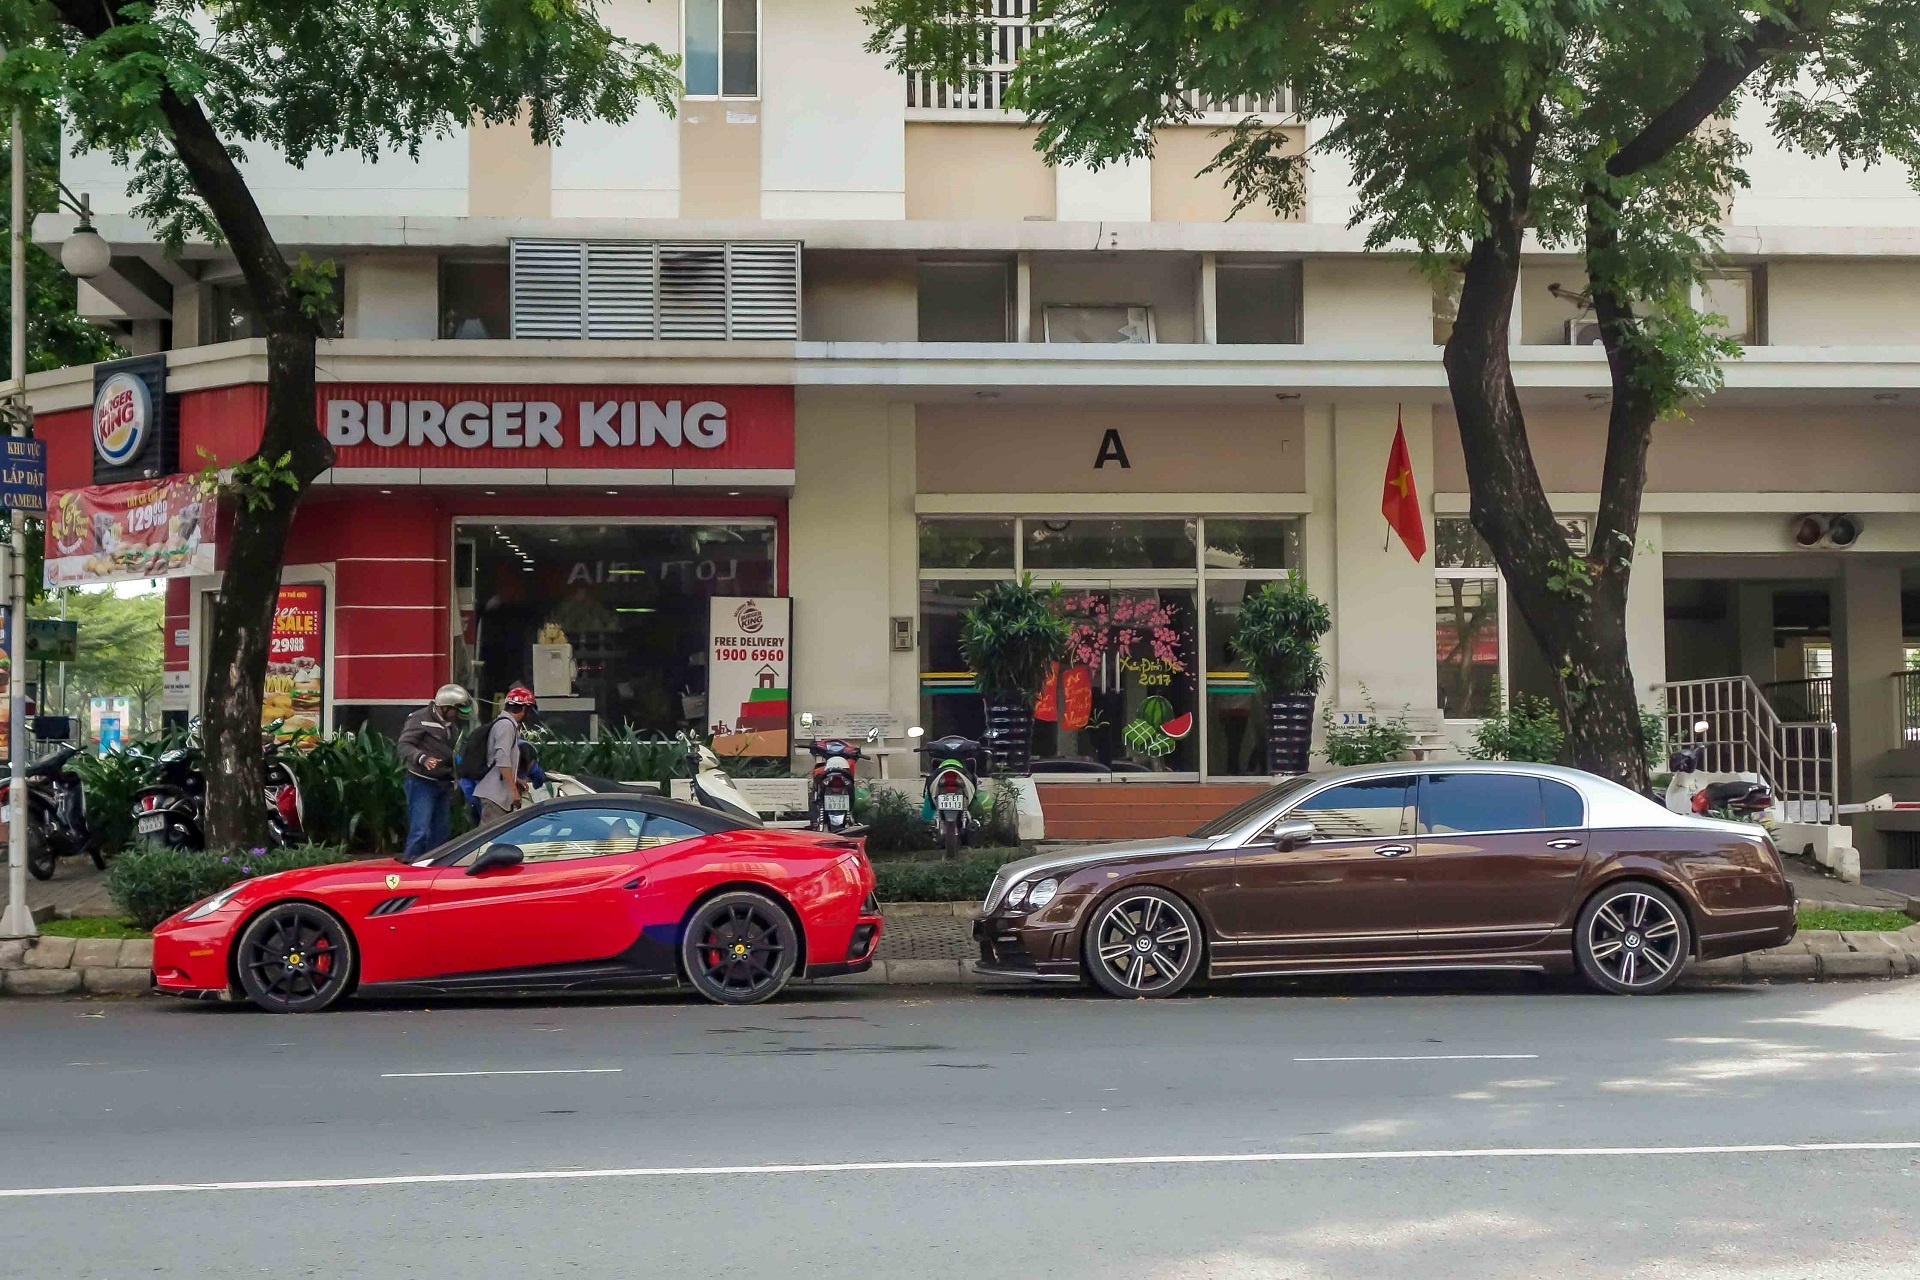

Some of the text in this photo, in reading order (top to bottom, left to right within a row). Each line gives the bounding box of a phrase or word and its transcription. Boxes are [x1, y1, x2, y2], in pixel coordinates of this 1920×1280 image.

[98, 389, 133, 420] BURGER
[98, 403, 134, 444] KING
[327, 399, 727, 449] BURGER KING
[7, 441, 25, 455] KHU
[1093, 428, 1131, 469] A
[4, 493, 42, 509] CAMERA
[127, 505, 153, 533] 129
[276, 615, 314, 631] SALE
[741, 616, 763, 627] KING
[714, 637, 784, 647] FREE DELIVERY
[715, 649, 784, 661] 1900 6960
[1138, 673, 1172, 686] 2017
